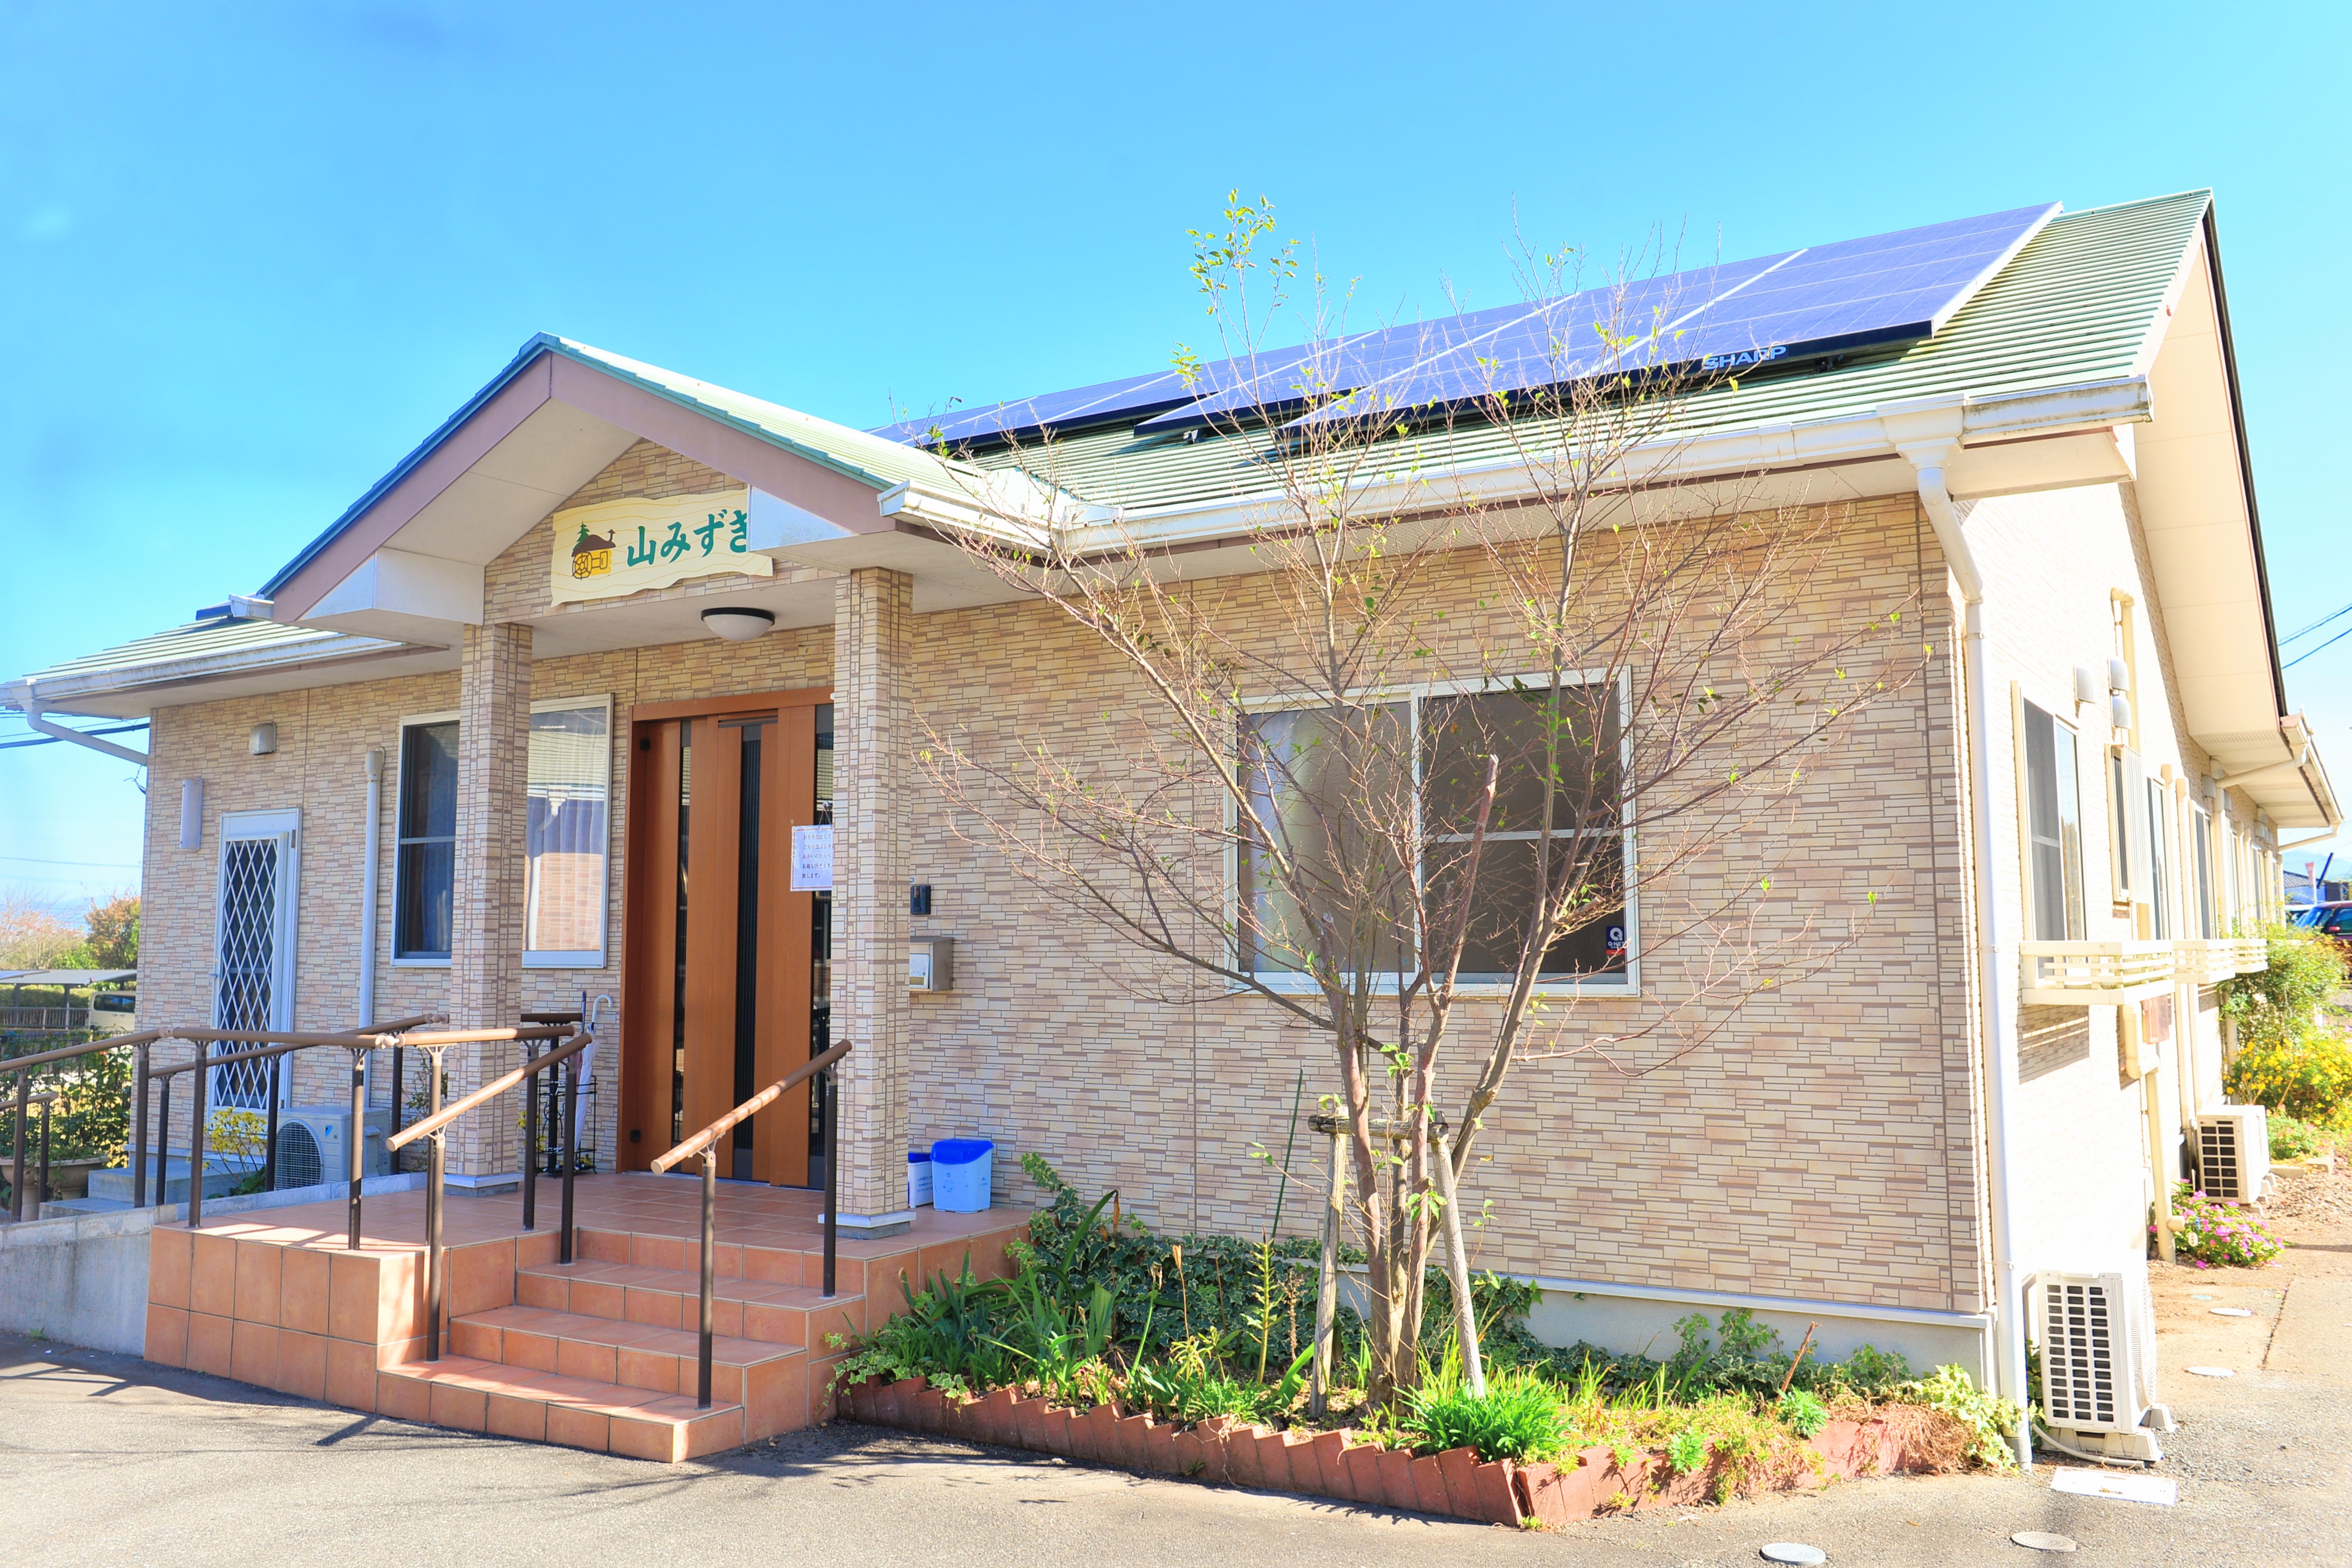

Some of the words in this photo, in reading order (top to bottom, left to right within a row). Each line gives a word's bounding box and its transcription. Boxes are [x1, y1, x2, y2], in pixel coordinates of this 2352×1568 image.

[1703, 346, 1787, 370] SHARP
[627, 509, 747, 567] 山みずき
